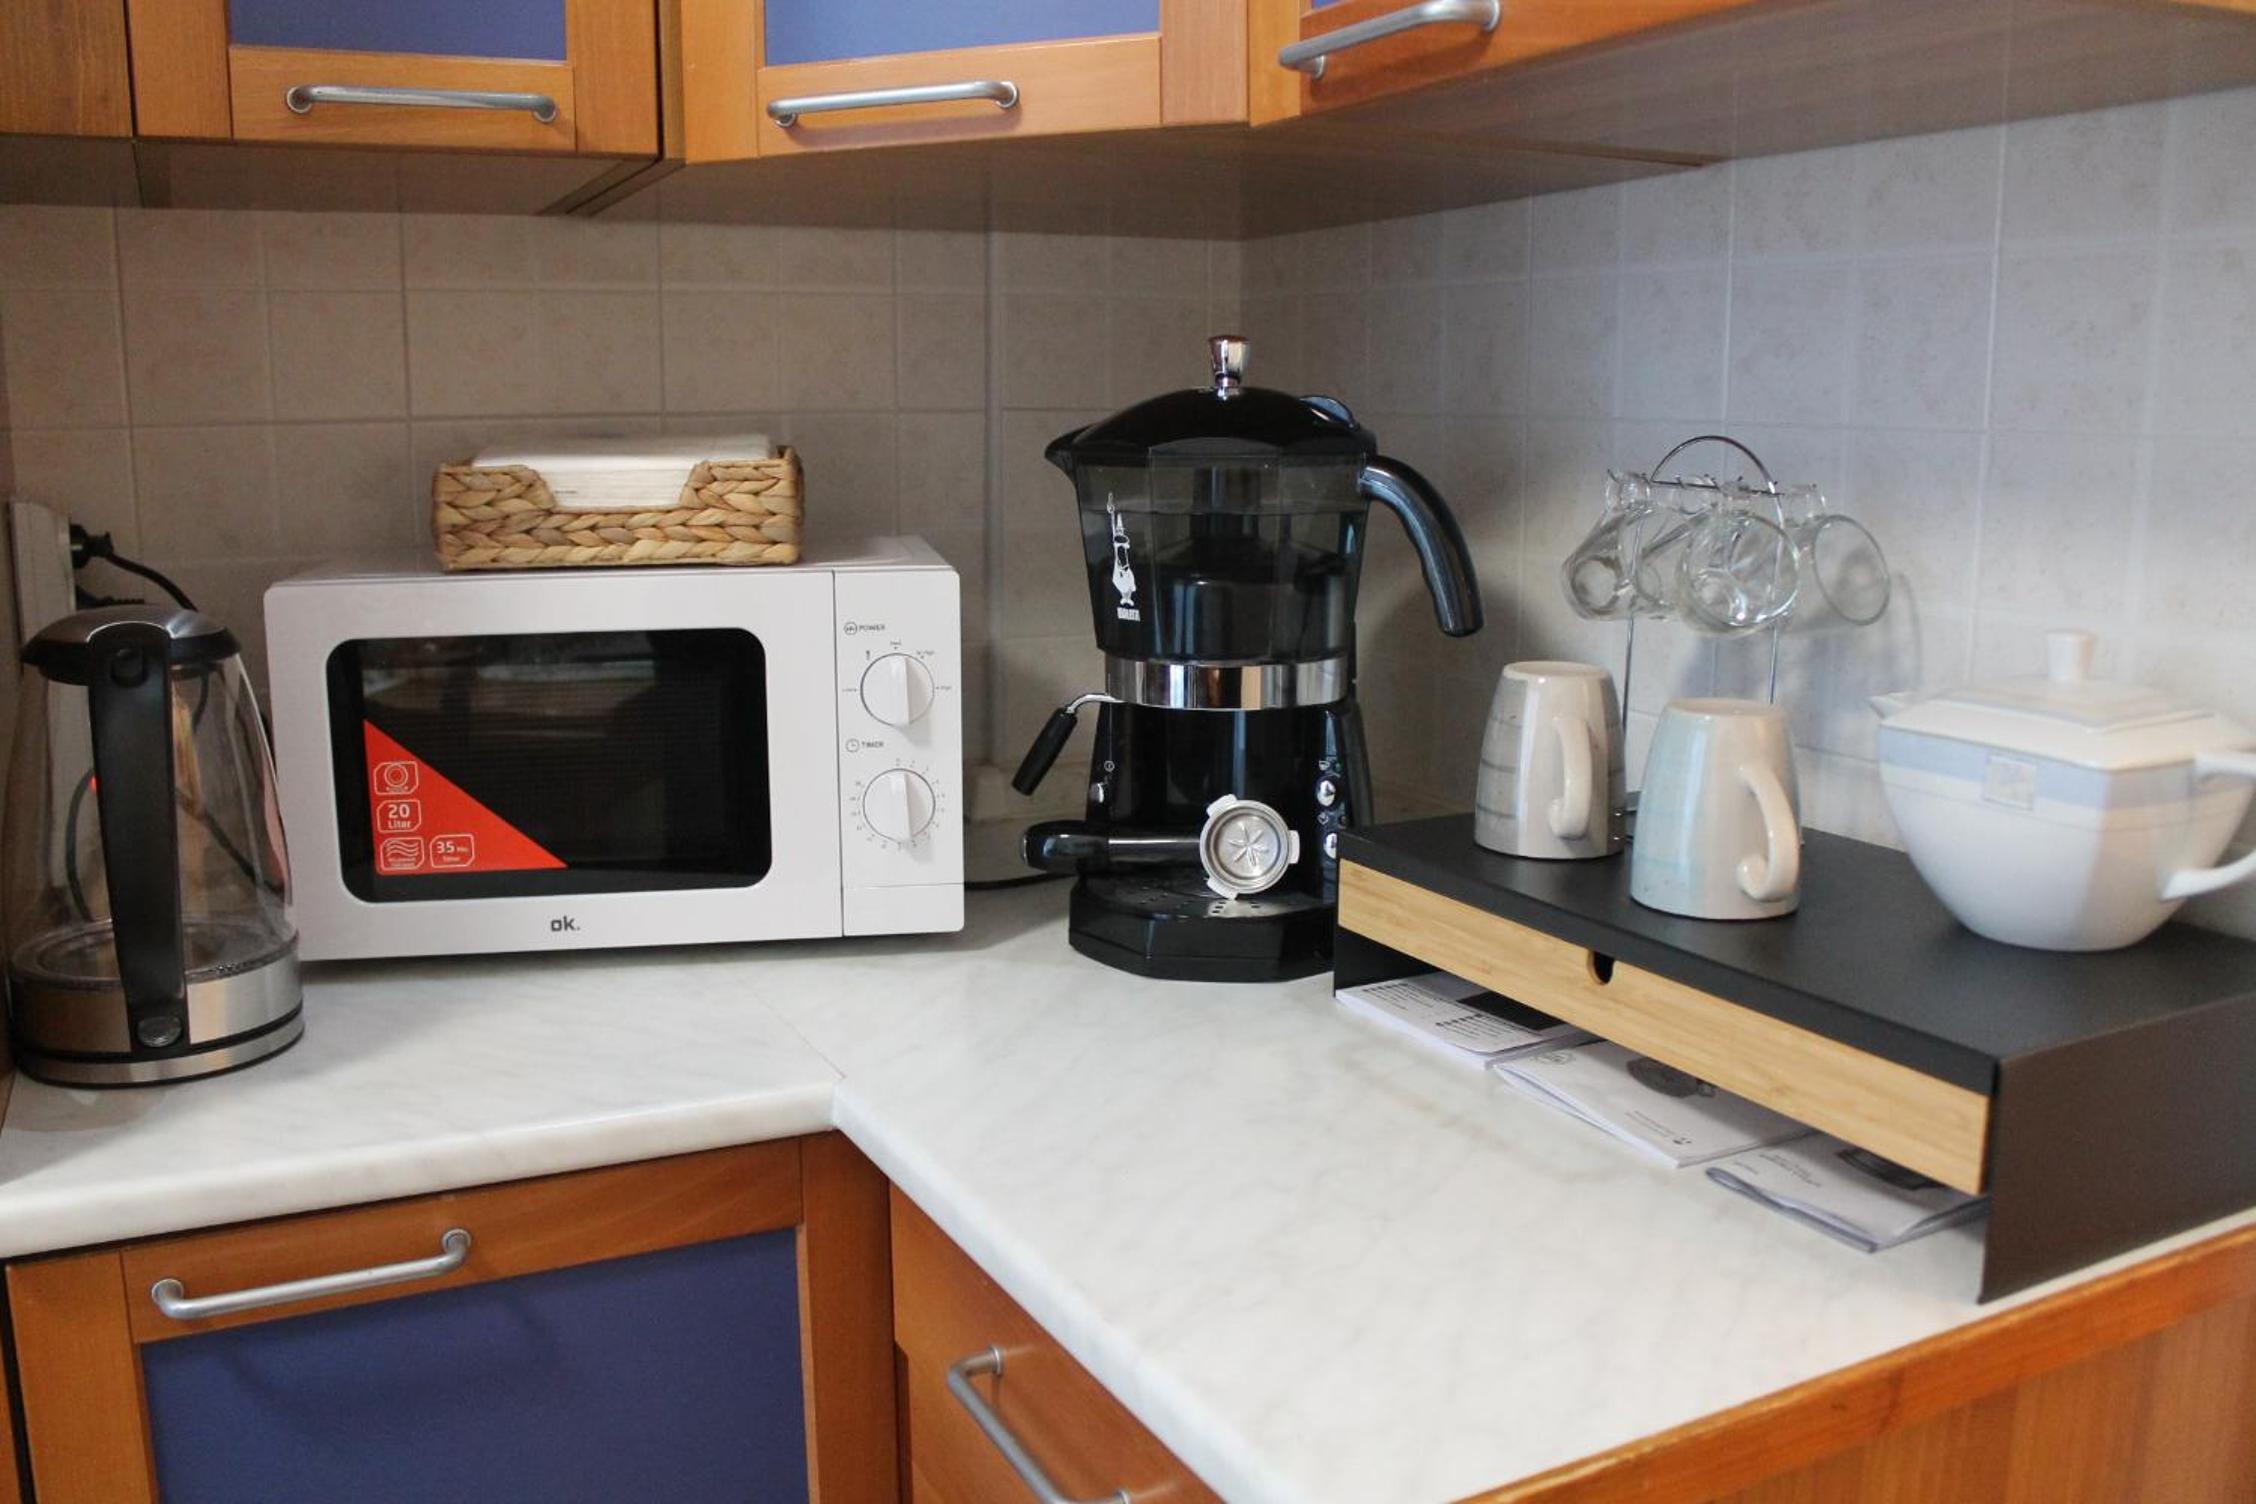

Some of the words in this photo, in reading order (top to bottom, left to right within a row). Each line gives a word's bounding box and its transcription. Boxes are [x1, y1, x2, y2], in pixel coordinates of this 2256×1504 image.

[858, 624, 886, 632] POWER
[861, 740, 884, 748] TIMER
[388, 804, 410, 818] 20
[436, 841, 455, 854] 35
